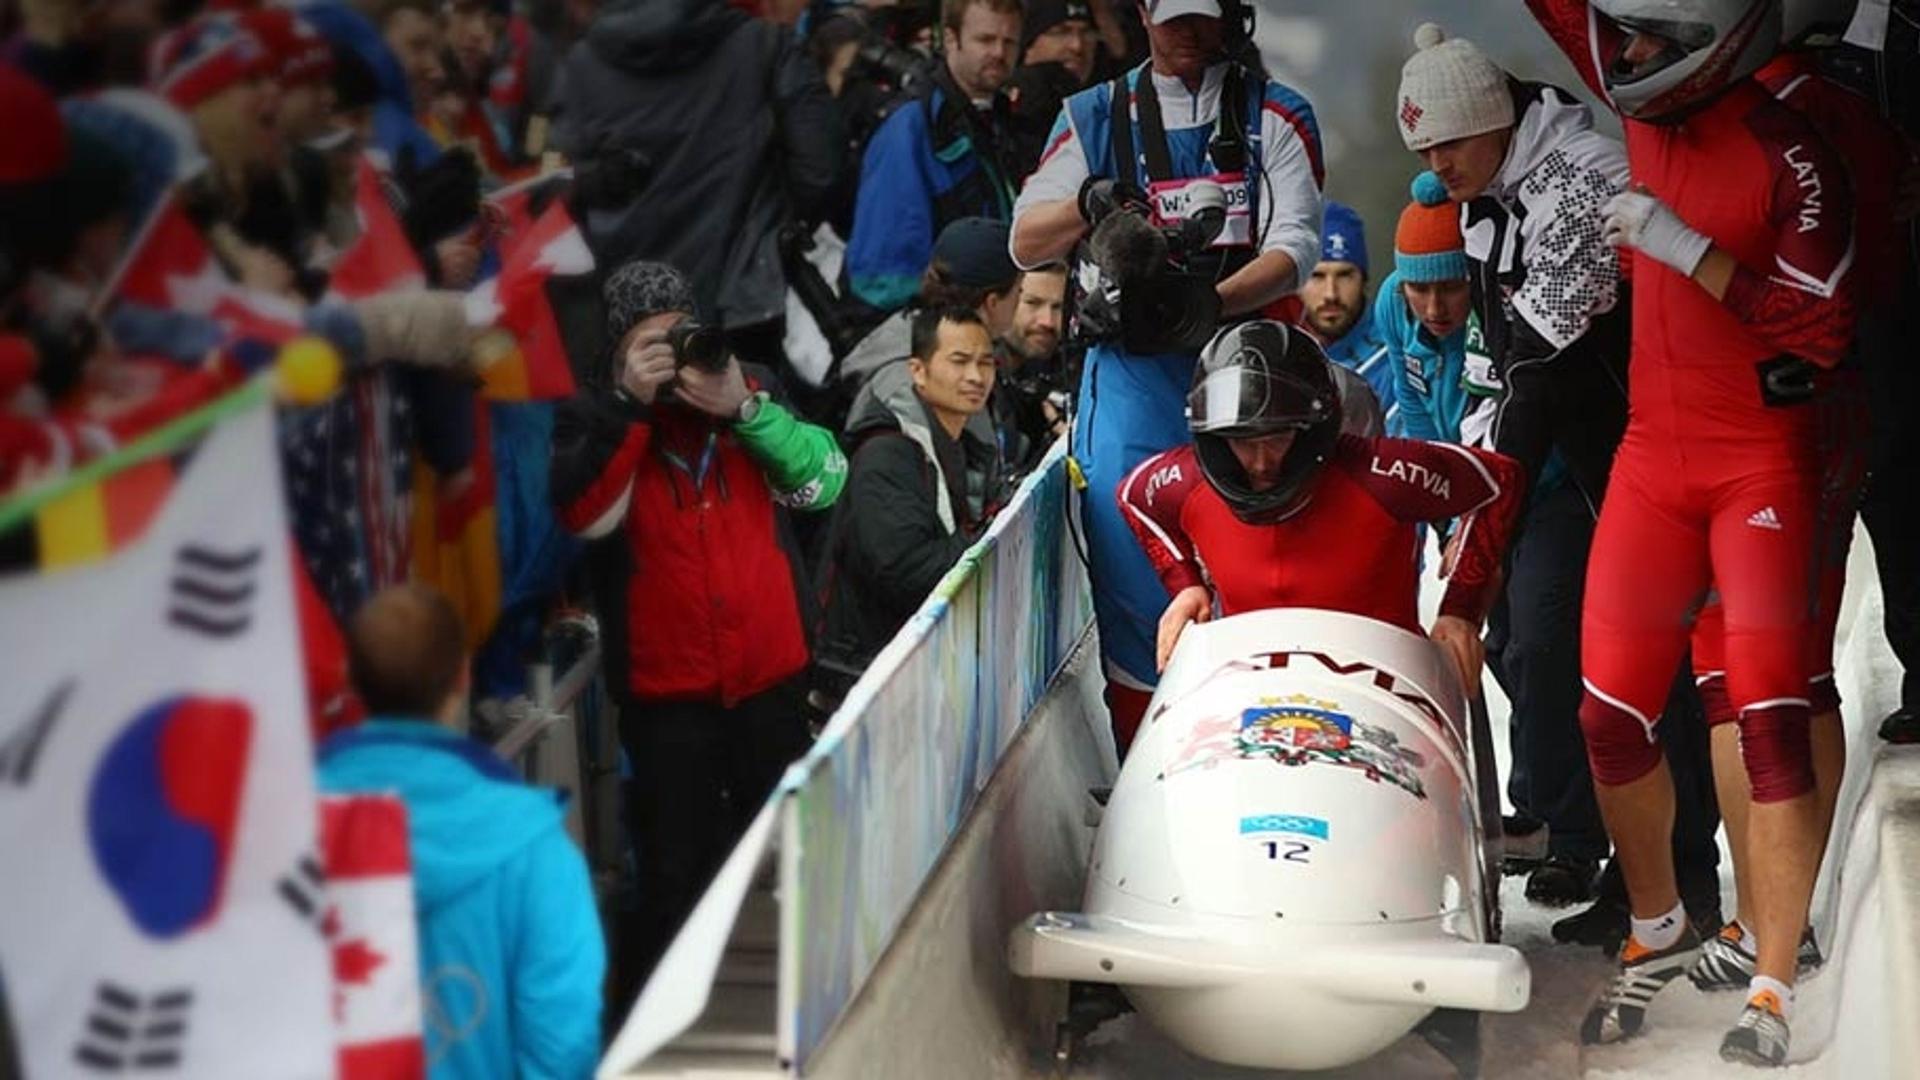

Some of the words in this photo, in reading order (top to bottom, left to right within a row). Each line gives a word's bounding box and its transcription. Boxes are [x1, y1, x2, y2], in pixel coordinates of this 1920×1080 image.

[1783, 145, 1821, 232] LATVIA
[1371, 456, 1450, 500] LATVIA
[1152, 650, 1443, 732] ATVIA
[1260, 841, 1310, 863] 12
